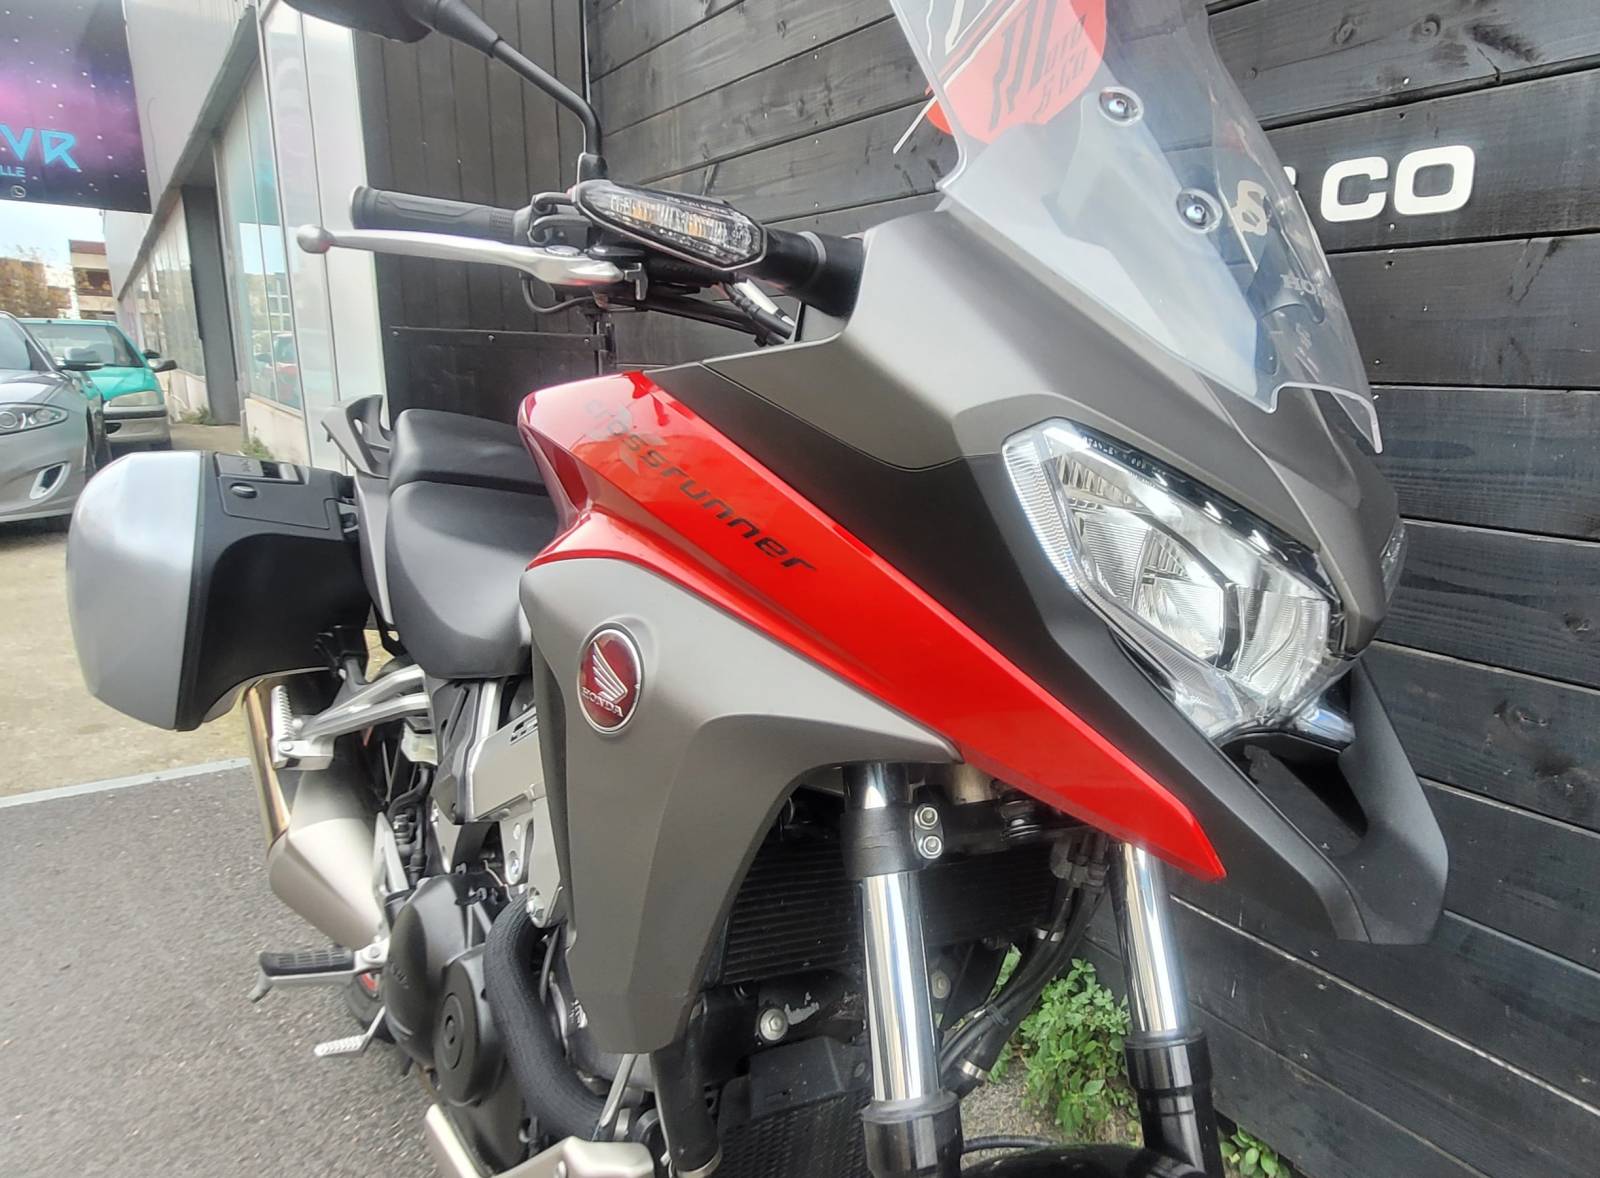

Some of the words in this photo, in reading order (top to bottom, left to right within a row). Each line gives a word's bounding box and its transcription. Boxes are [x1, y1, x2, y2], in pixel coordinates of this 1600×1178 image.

[1320, 145, 1476, 223] CO
[584, 398, 817, 572] crossrunner
[581, 686, 625, 718] HONDA
